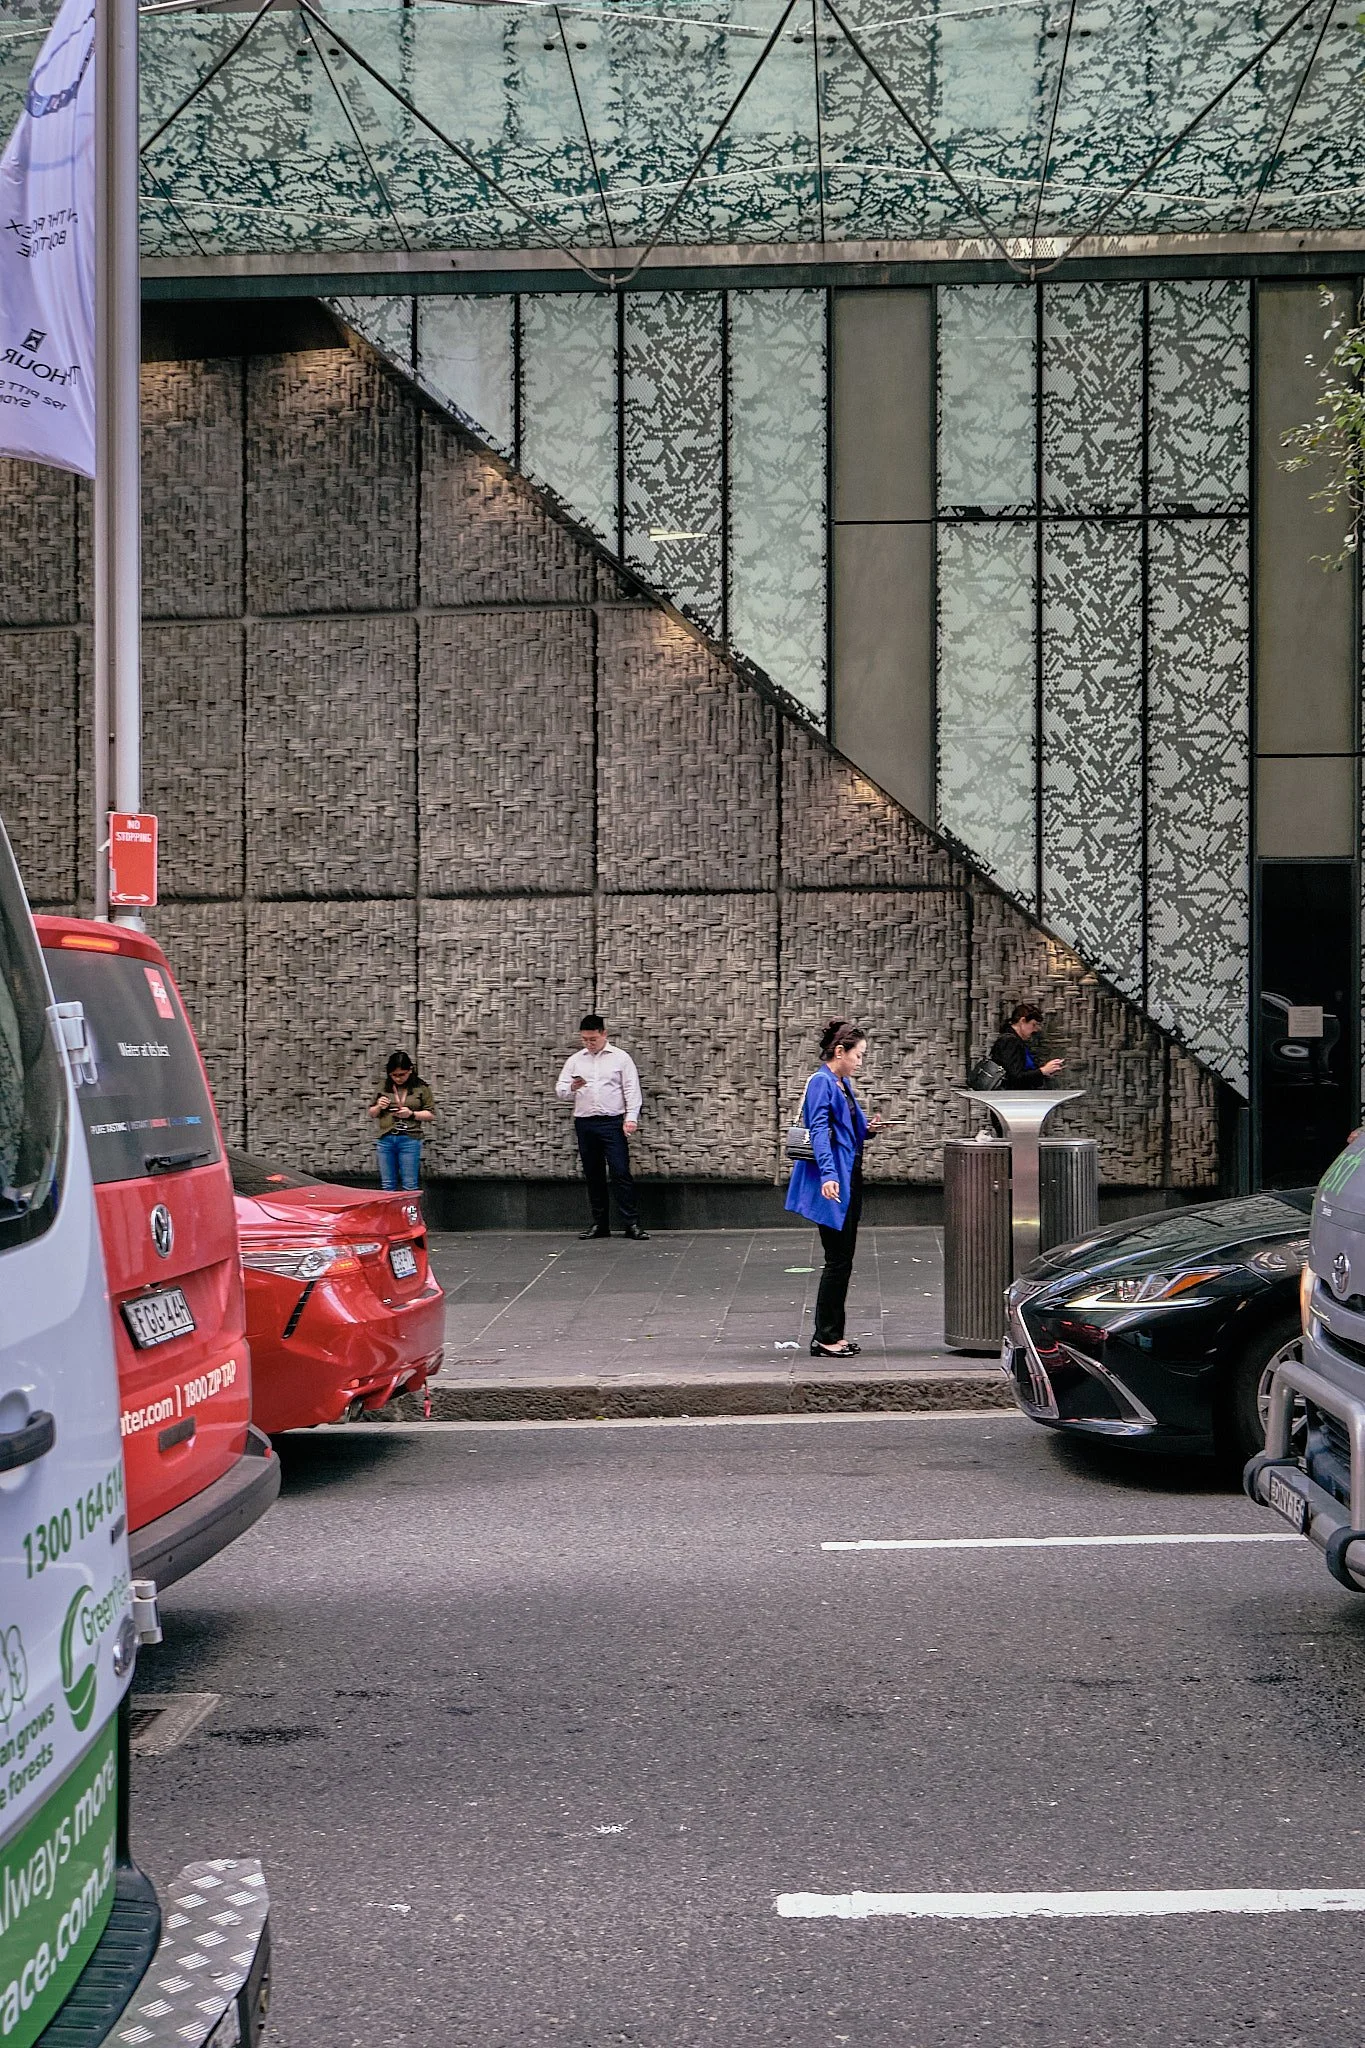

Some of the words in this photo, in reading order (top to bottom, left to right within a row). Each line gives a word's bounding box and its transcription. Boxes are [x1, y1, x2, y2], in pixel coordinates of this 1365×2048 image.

[115, 831, 152, 843] STOPPING
[126, 819, 141, 830] NO
[184, 1375, 208, 1408] 1800
[206, 1368, 222, 1396] ZIP
[220, 1359, 237, 1388] TAP
[22, 1507, 72, 1580] 1300
[77, 1482, 105, 1540] 164
[17, 1703, 55, 1760] grows
[8, 1742, 54, 1800] forests
[0, 1816, 71, 1935] lways
[73, 1749, 115, 1846] more
